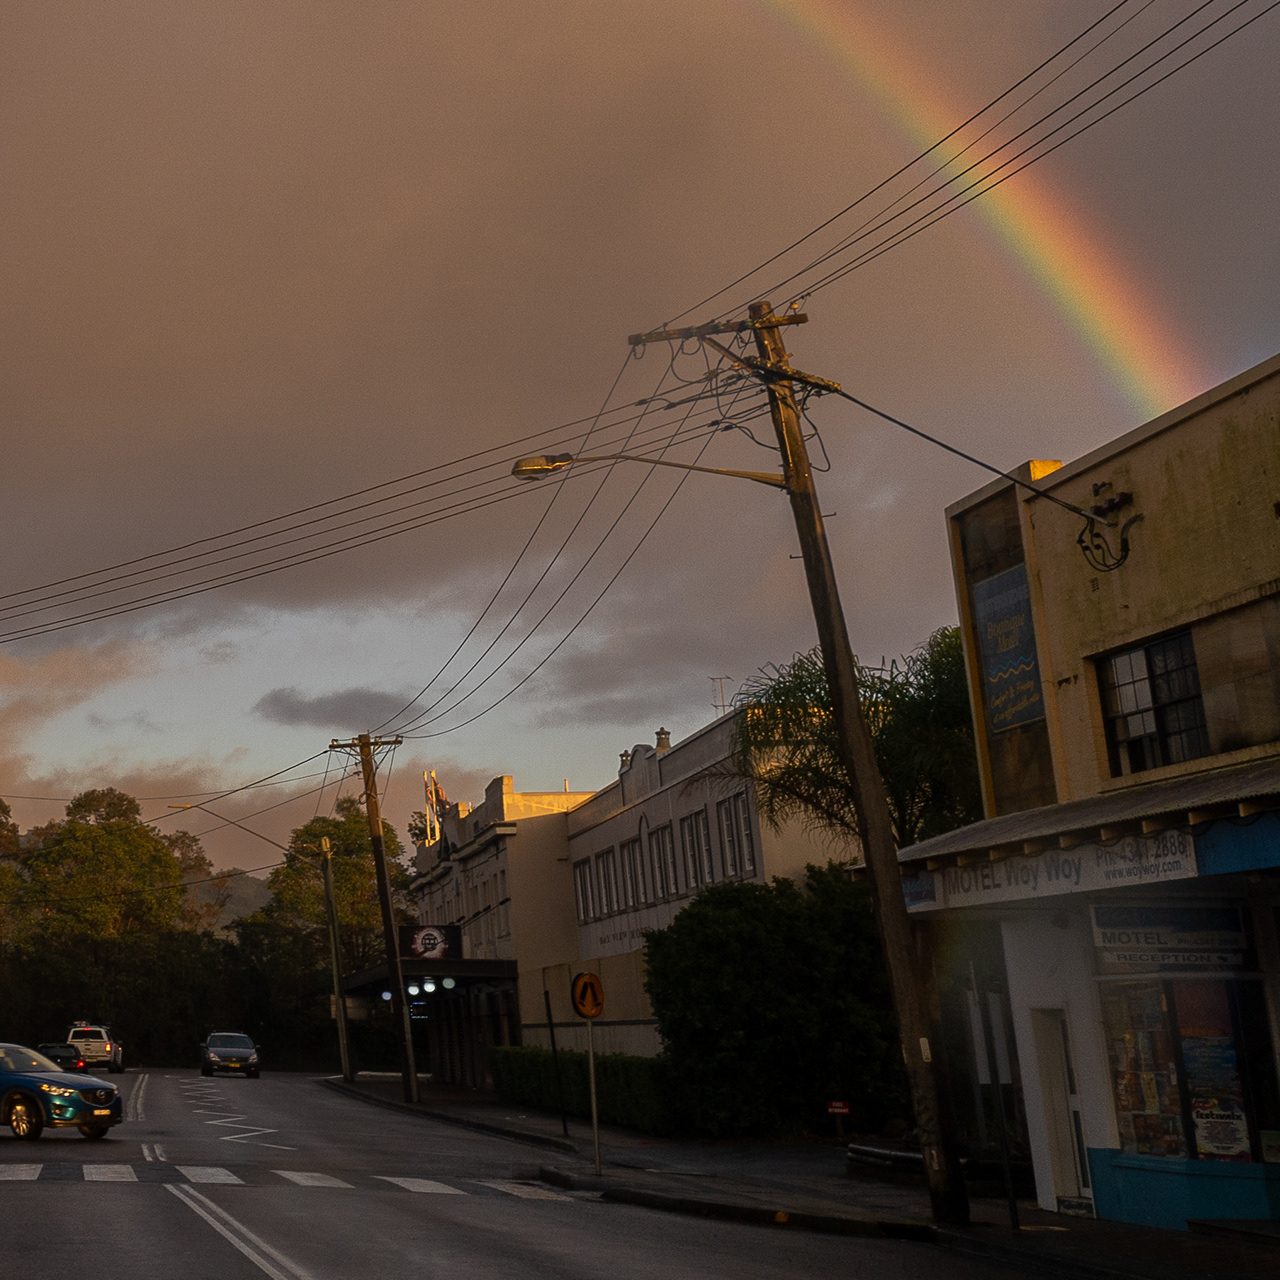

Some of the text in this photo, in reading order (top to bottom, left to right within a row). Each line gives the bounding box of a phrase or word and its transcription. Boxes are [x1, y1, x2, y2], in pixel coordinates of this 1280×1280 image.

[948, 852, 1082, 896] MOTEL Woy Woy
[1104, 860, 1182, 880] www.woywoy.com
[1101, 931, 1169, 945] MOTEL
[1116, 953, 1212, 963] RECEPTION
